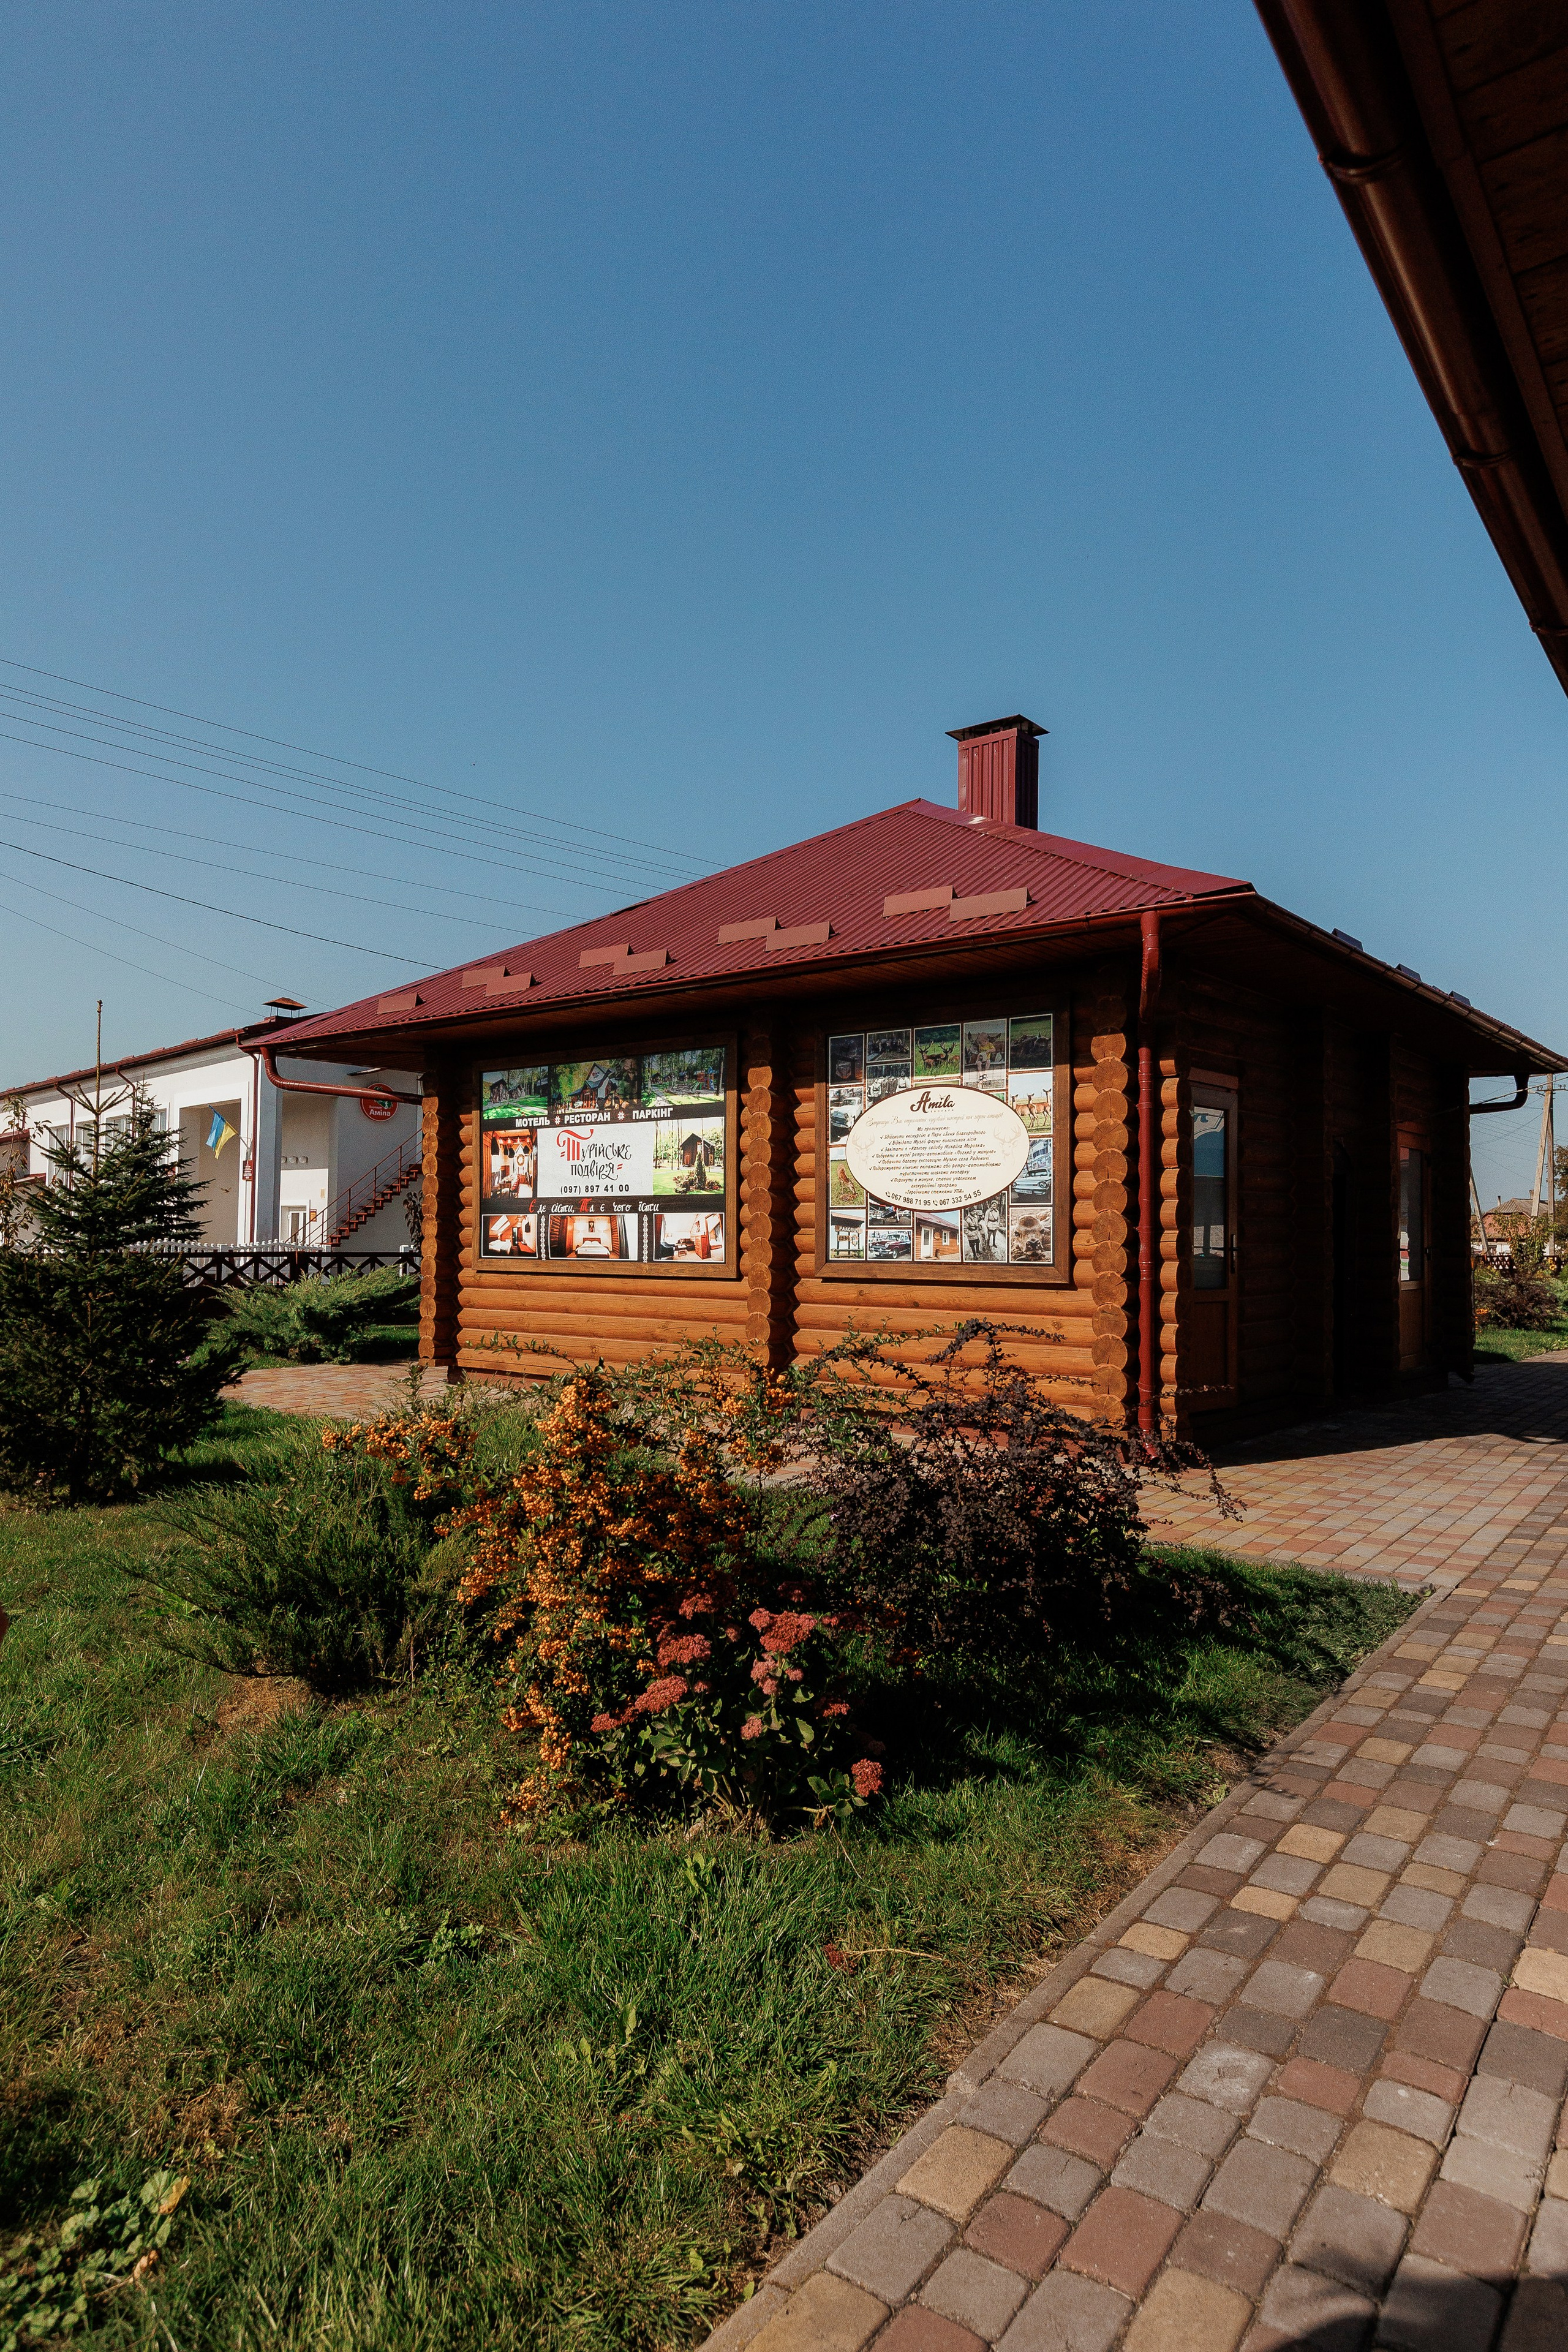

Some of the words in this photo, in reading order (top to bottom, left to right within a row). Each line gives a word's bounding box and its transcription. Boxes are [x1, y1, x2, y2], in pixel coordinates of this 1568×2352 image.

[910, 1091, 956, 1114] Amila
[516, 1117, 550, 1128] МОТЕЛЬ
[564, 1112, 611, 1124] РЕСТОРАН
[632, 1107, 673, 1120] ПАРКІНГ
[560, 1186, 581, 1194] (097)
[891, 1193, 902, 1201] 067
[951, 1196, 962, 1204] 332
[537, 1204, 546, 1214] де
[612, 1202, 631, 1212] чого
[638, 1201, 659, 1212] їсти
